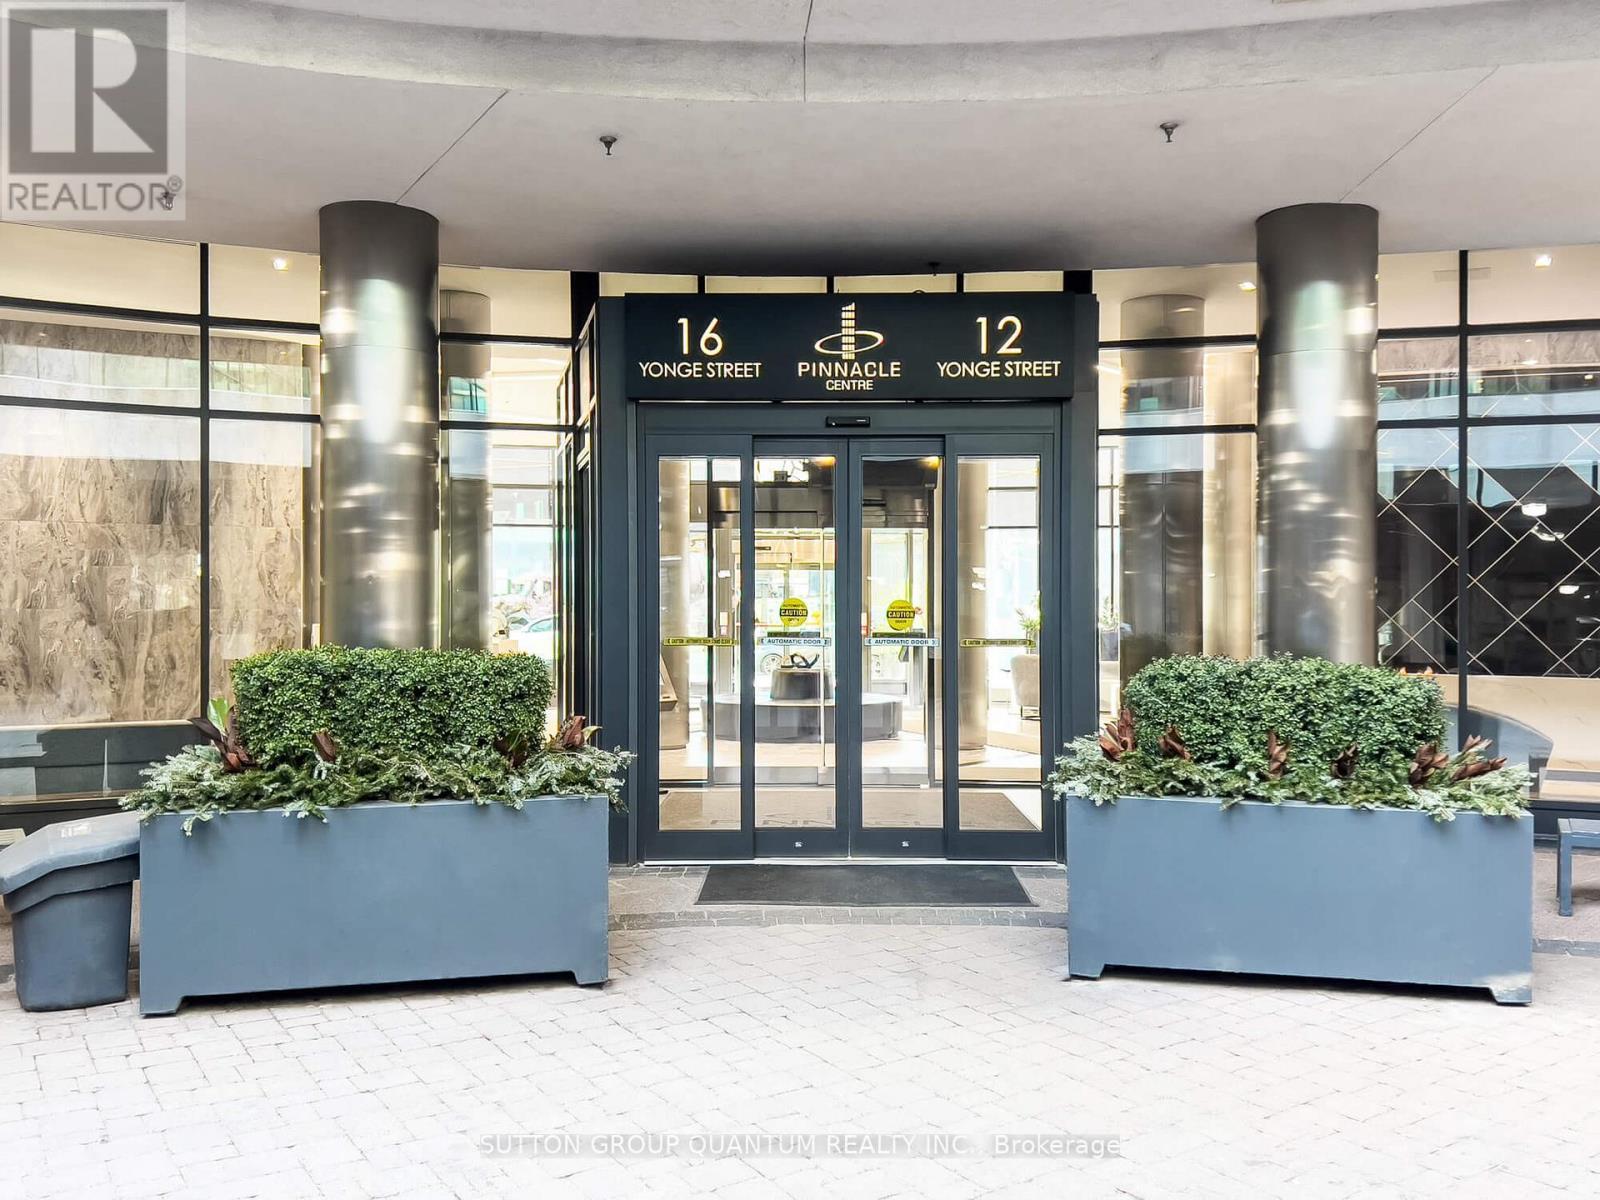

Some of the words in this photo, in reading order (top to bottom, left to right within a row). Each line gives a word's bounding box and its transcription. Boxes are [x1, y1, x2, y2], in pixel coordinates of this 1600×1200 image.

[678, 318, 723, 356] 16
[975, 315, 1023, 355] 12
[639, 362, 703, 378] YONGE
[706, 362, 762, 378] STREET
[797, 361, 901, 378] PINNACLE
[936, 361, 1001, 378] YONGE
[1003, 361, 1062, 378] STREET
[825, 379, 874, 391] CENTRE
